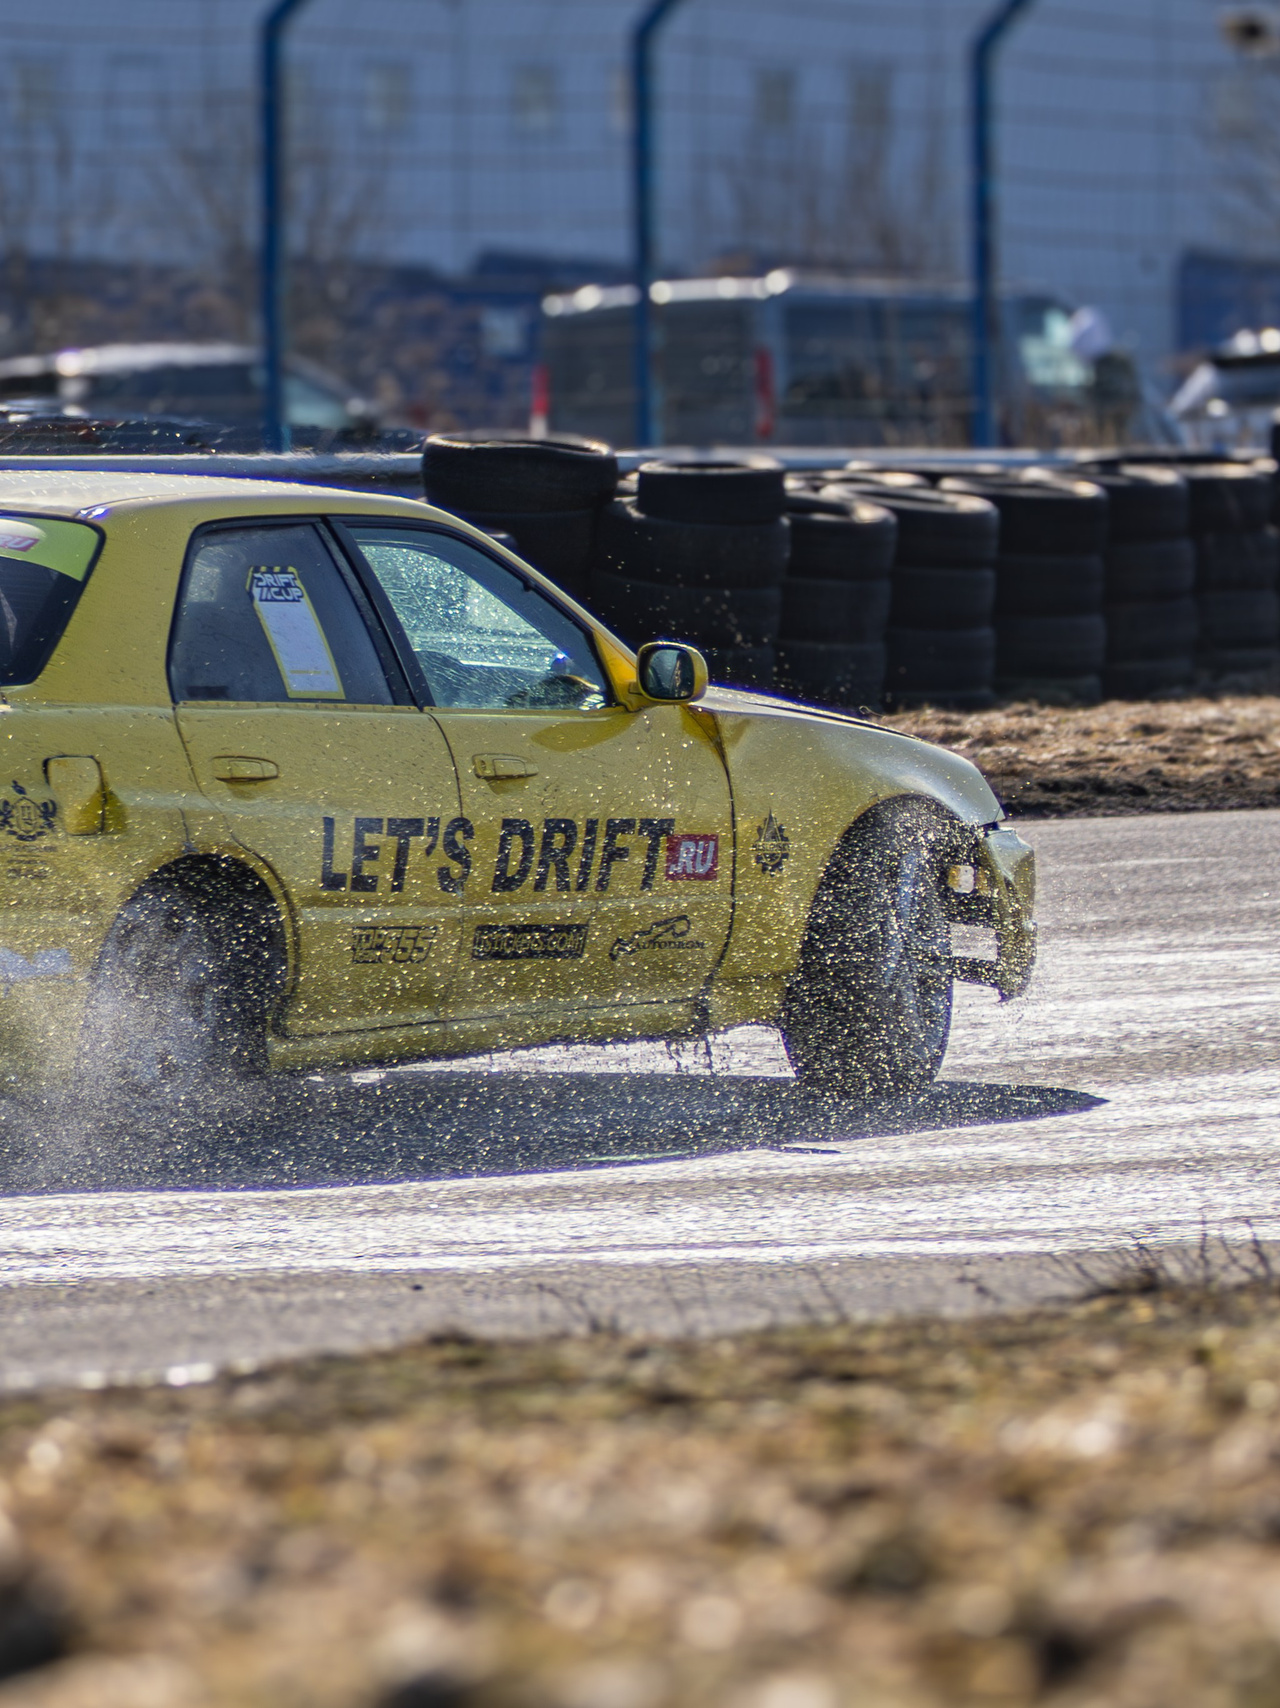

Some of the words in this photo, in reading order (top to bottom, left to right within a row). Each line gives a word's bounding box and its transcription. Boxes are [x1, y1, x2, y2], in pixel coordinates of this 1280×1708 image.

[253, 573, 297, 587] DRIFT
[271, 587, 303, 600] CUP
[321, 816, 475, 893] LET'S
